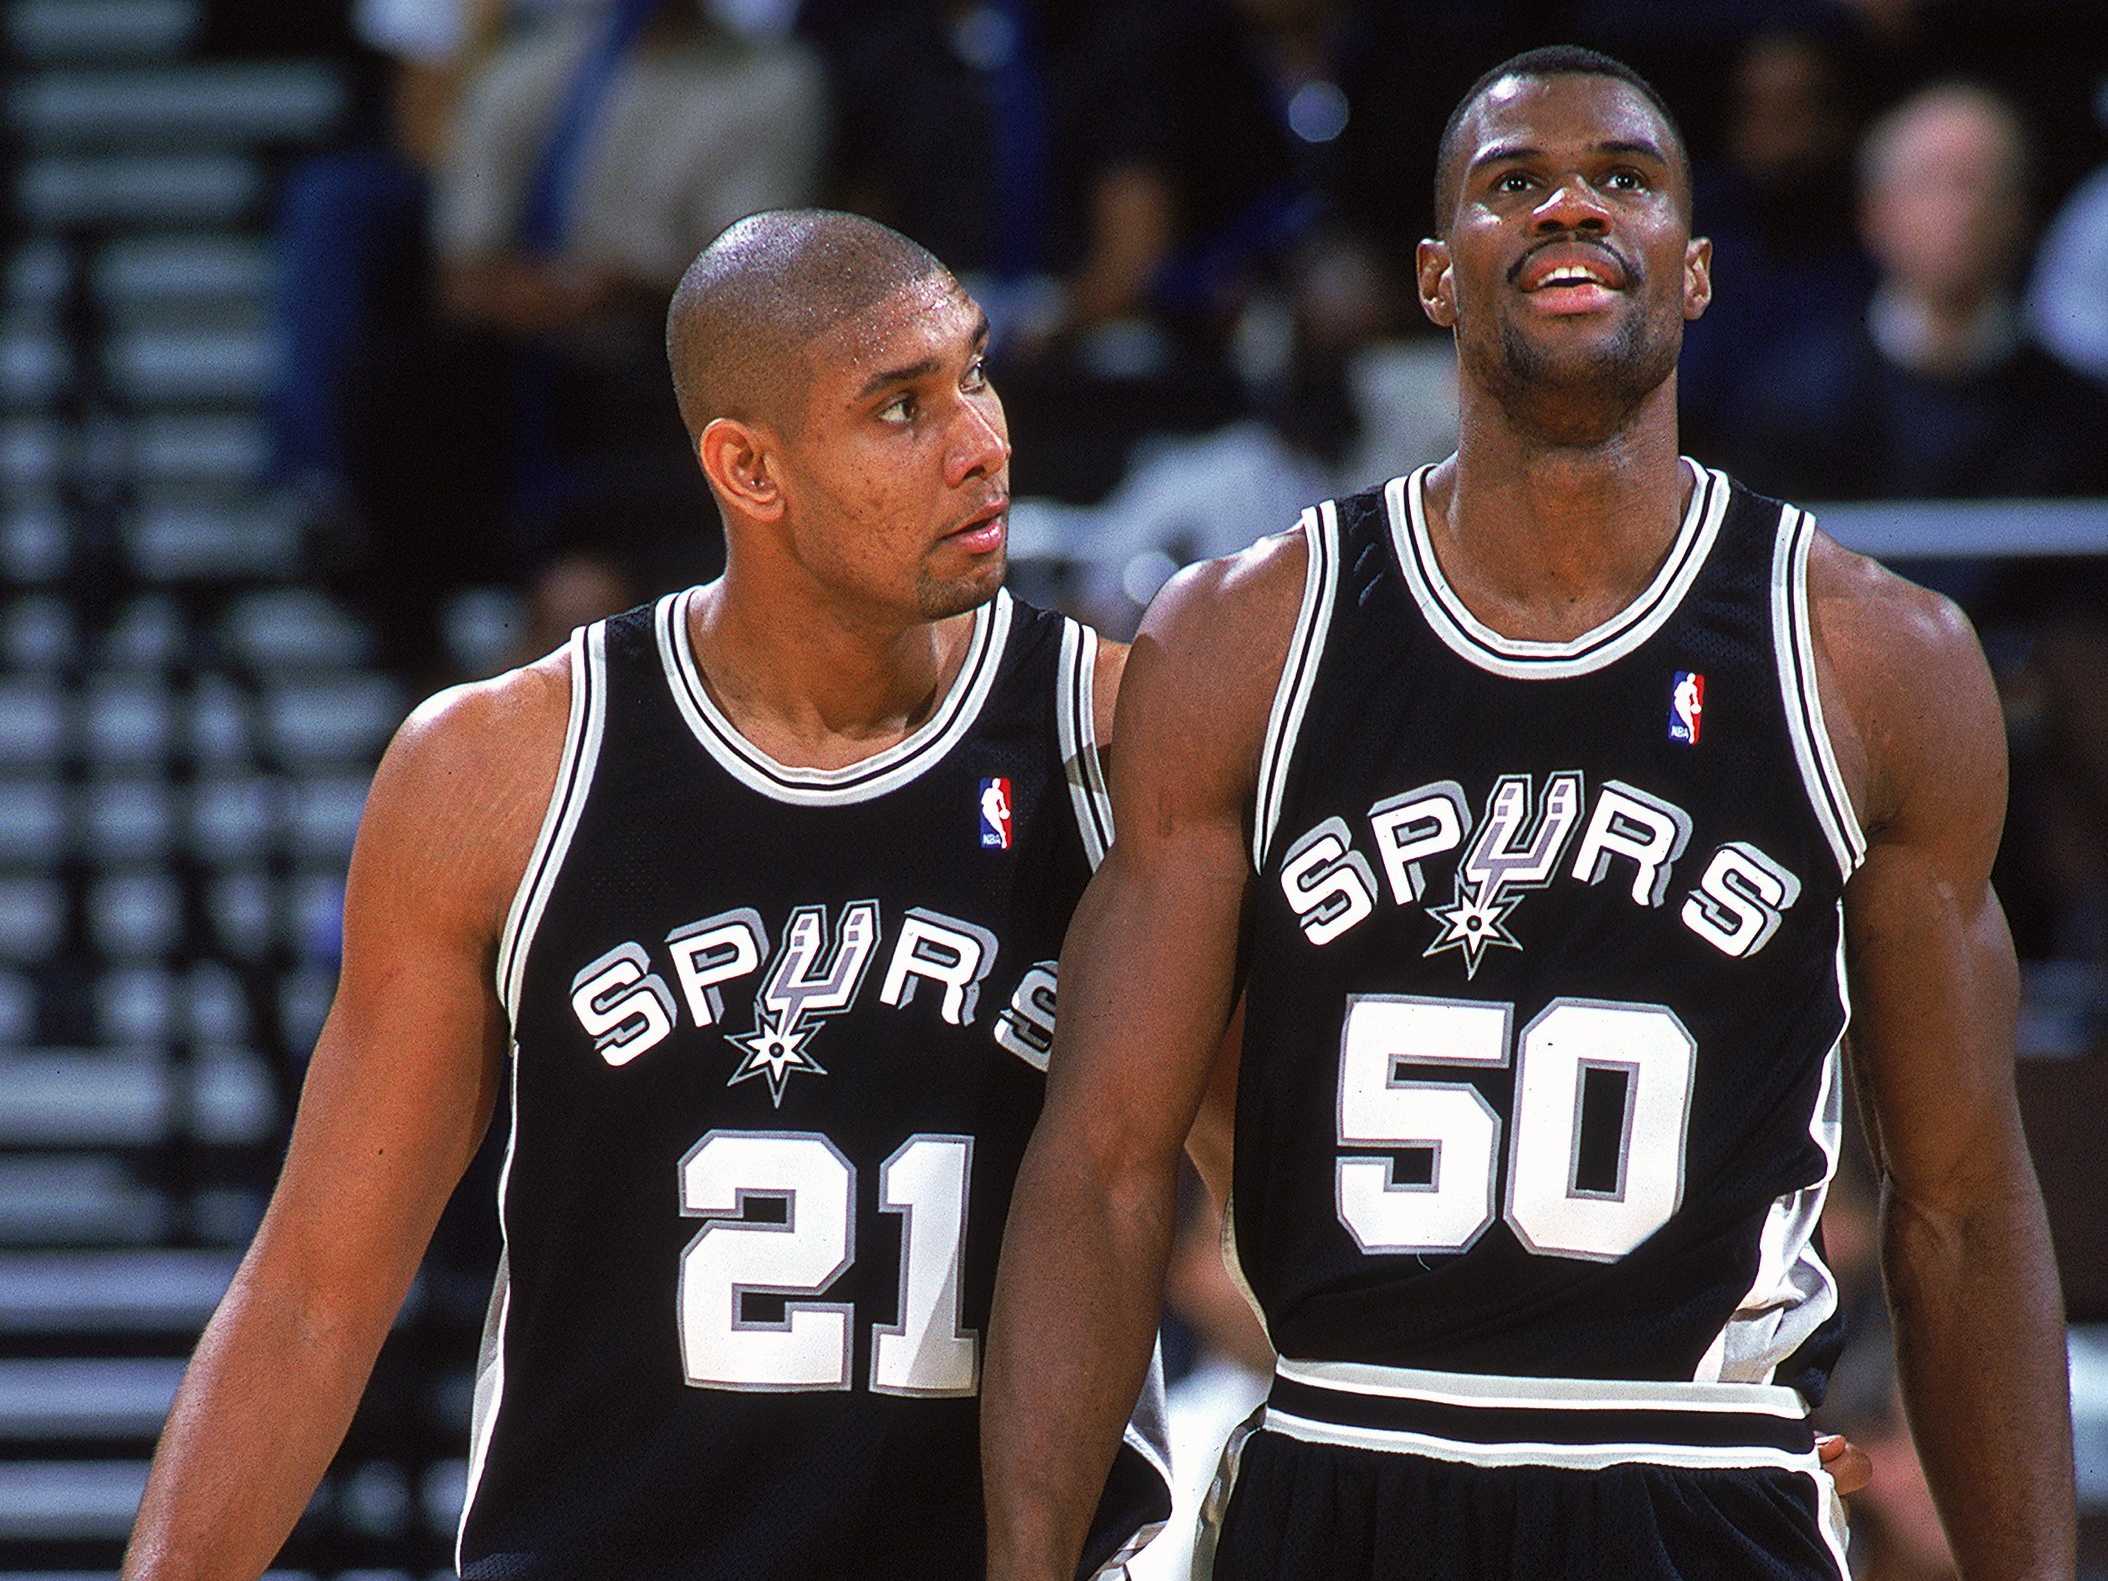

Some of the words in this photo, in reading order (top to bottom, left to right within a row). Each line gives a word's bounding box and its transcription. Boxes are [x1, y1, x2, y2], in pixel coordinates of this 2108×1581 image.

[1280, 770, 1801, 980] SPURS
[1336, 993, 1698, 1264] 50
[676, 1129, 980, 1399] 21
